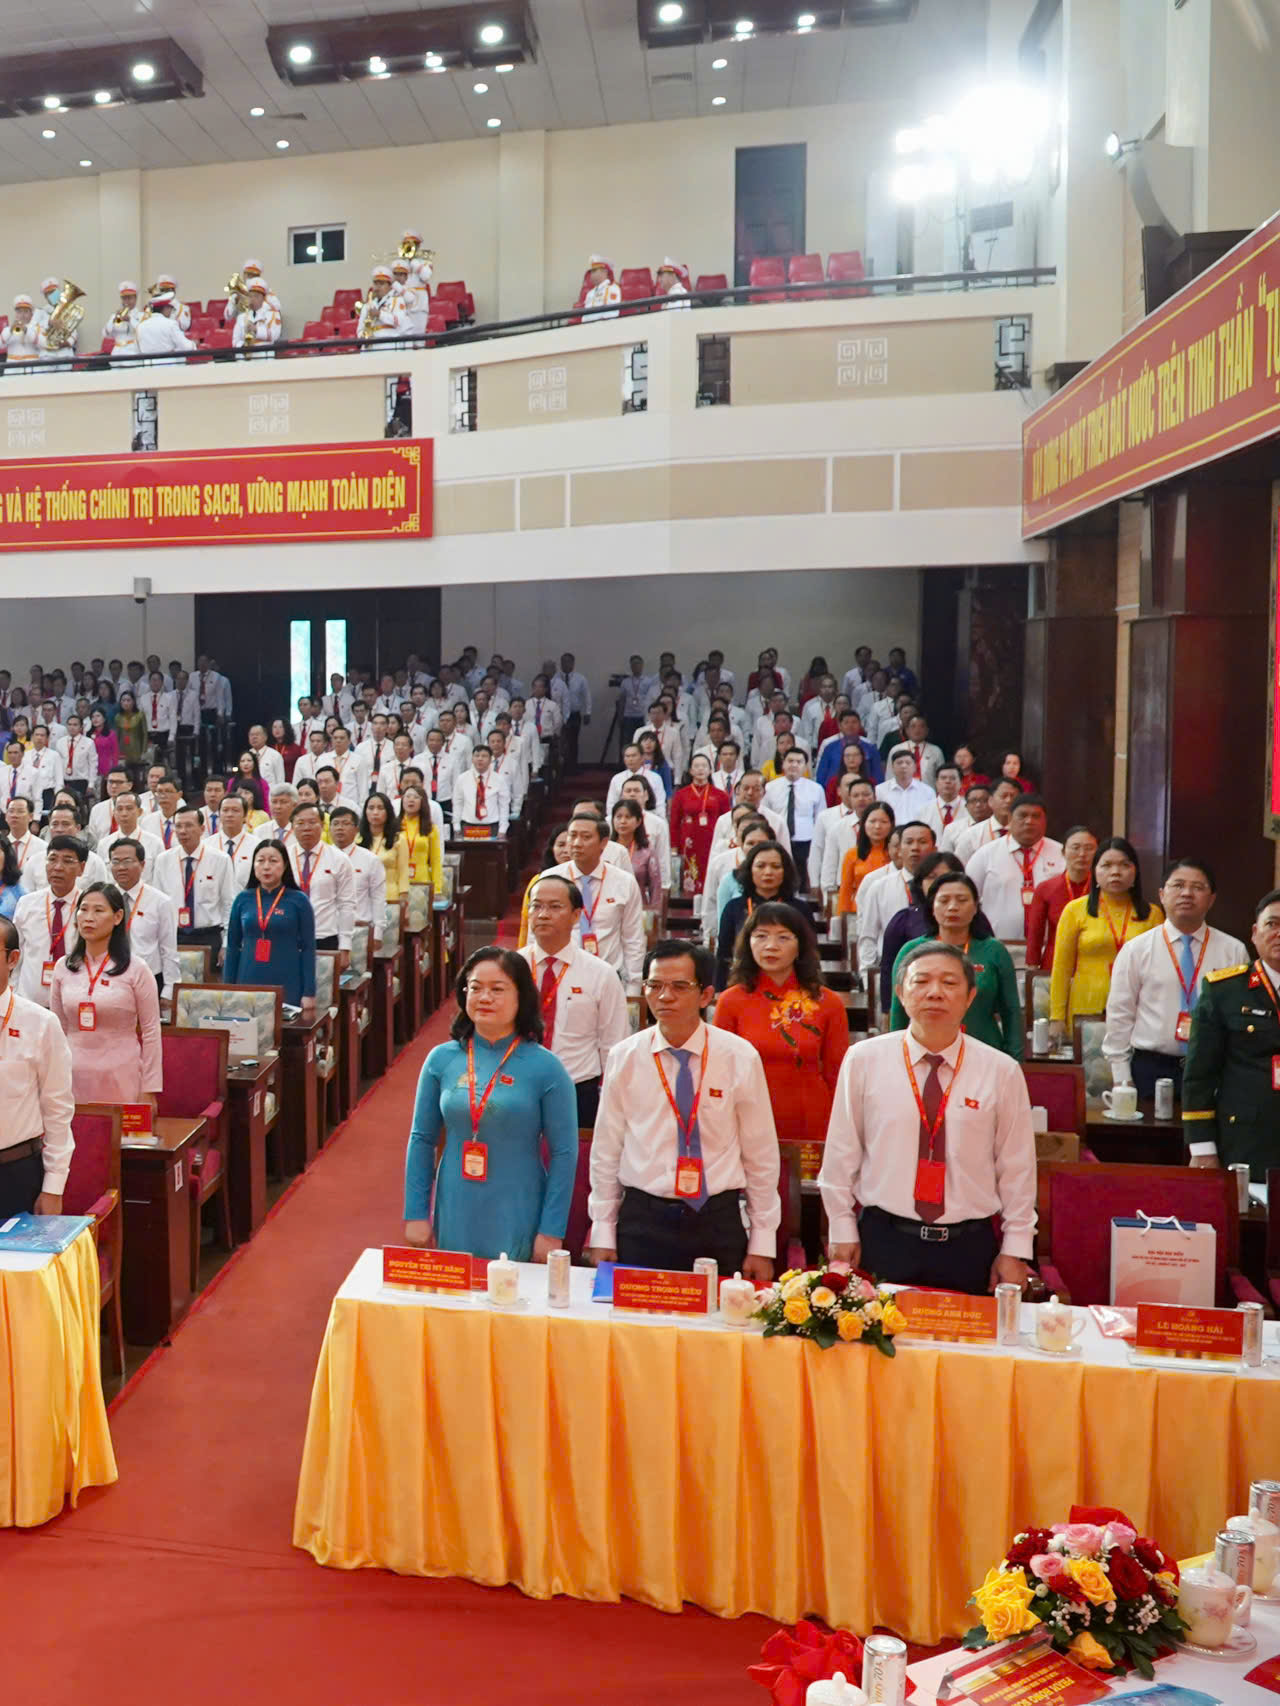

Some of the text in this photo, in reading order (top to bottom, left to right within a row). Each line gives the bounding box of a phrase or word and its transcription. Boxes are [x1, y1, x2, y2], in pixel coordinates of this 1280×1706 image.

[1128, 359, 1155, 449] NƯỚC
[1158, 340, 1185, 434] TRÊN
[1188, 330, 1215, 419] TINH
[1219, 282, 1254, 403] THẦN
[6, 486, 23, 523] VÀ
[25, 485, 42, 529] HỆ
[45, 480, 87, 521] THỐNG
[90, 482, 130, 520] CHÍNH
[133, 487, 153, 525] TRỊ
[156, 484, 200, 517] TRONG
[203, 483, 244, 522] SẠCH,
[247, 476, 283, 514] VỮNG
[287, 480, 329, 519] MẠNH
[332, 471, 369, 510] TOÀN
[372, 470, 406, 516] DIỆN
